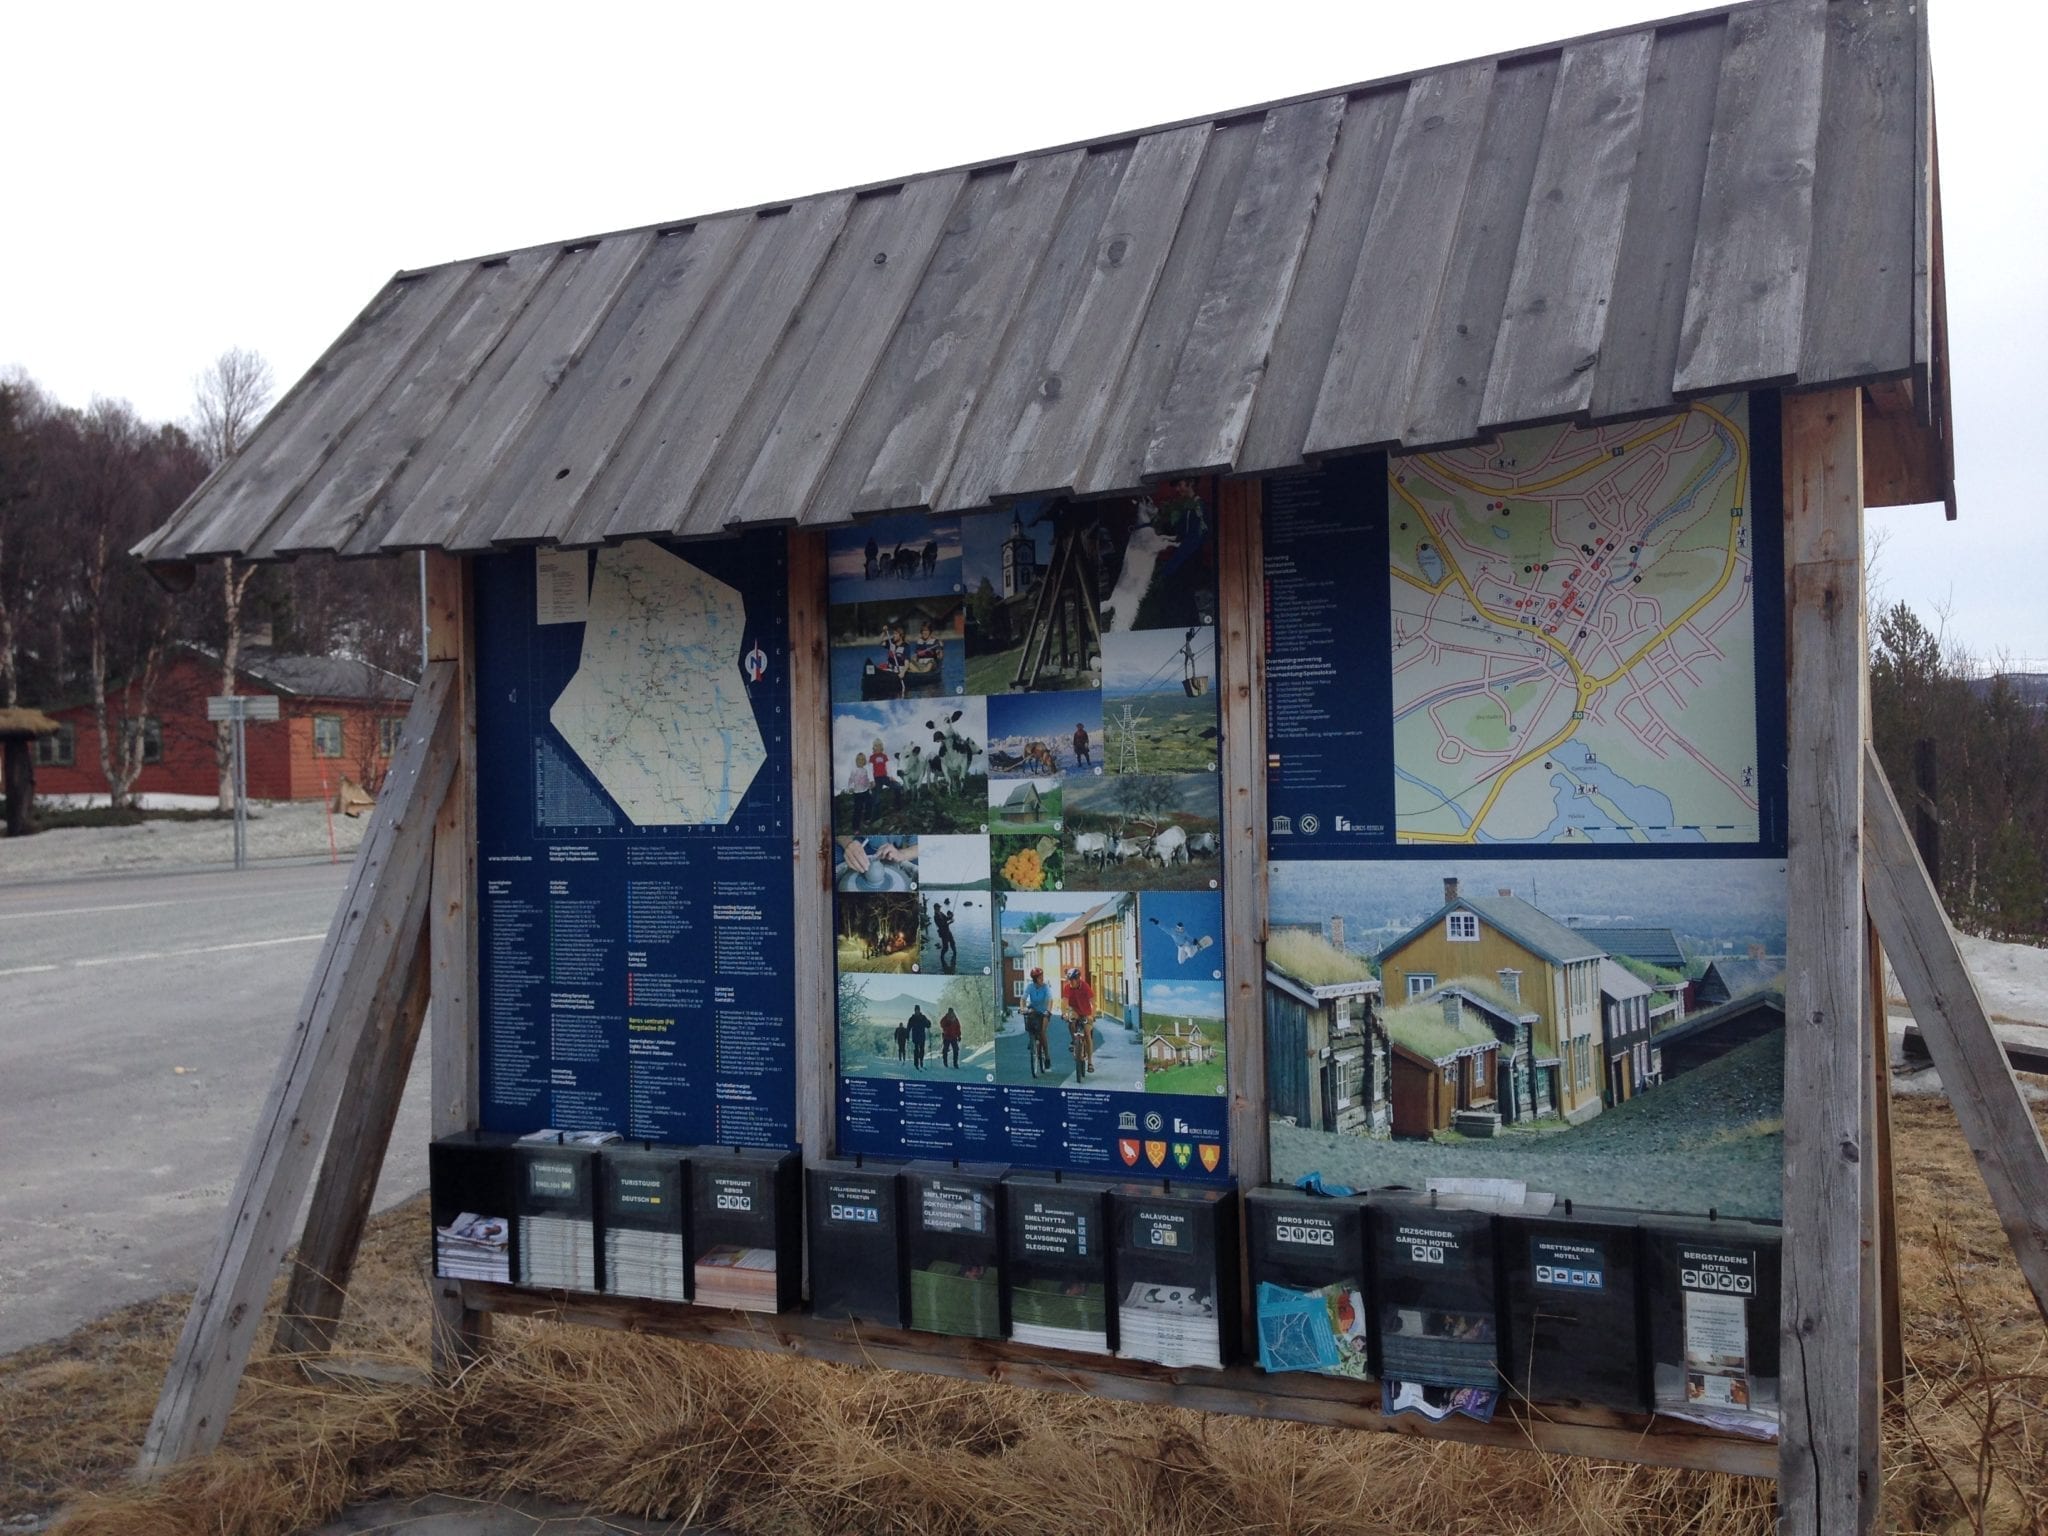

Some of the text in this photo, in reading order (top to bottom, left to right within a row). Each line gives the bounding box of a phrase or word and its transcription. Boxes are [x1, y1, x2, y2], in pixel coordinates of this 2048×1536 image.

[621, 1178, 660, 1188] TURISTGUIDE
[714, 1179, 752, 1187] VERTSHUSET
[621, 1195, 650, 1203] DEUTSCH
[1025, 1214, 1066, 1224] SMELTHYTTA
[1140, 1212, 1184, 1222] GALÅVOLDEN
[1304, 1218, 1332, 1227] HOTELL
[1025, 1224, 1076, 1234] DOKTORTJØNNA
[1400, 1227, 1455, 1238] ERZSCHEIDER-
[1025, 1234, 1067, 1243] OLAVSGRUVA
[1396, 1236, 1459, 1249] GÅRDEN HOTELL
[1025, 1243, 1064, 1252] SLEGGVEIEN
[1539, 1243, 1595, 1253] IDRETTSPARKEN
[1684, 1252, 1748, 1264] BERGSTADENS
[1701, 1264, 1731, 1273] HOTEL
